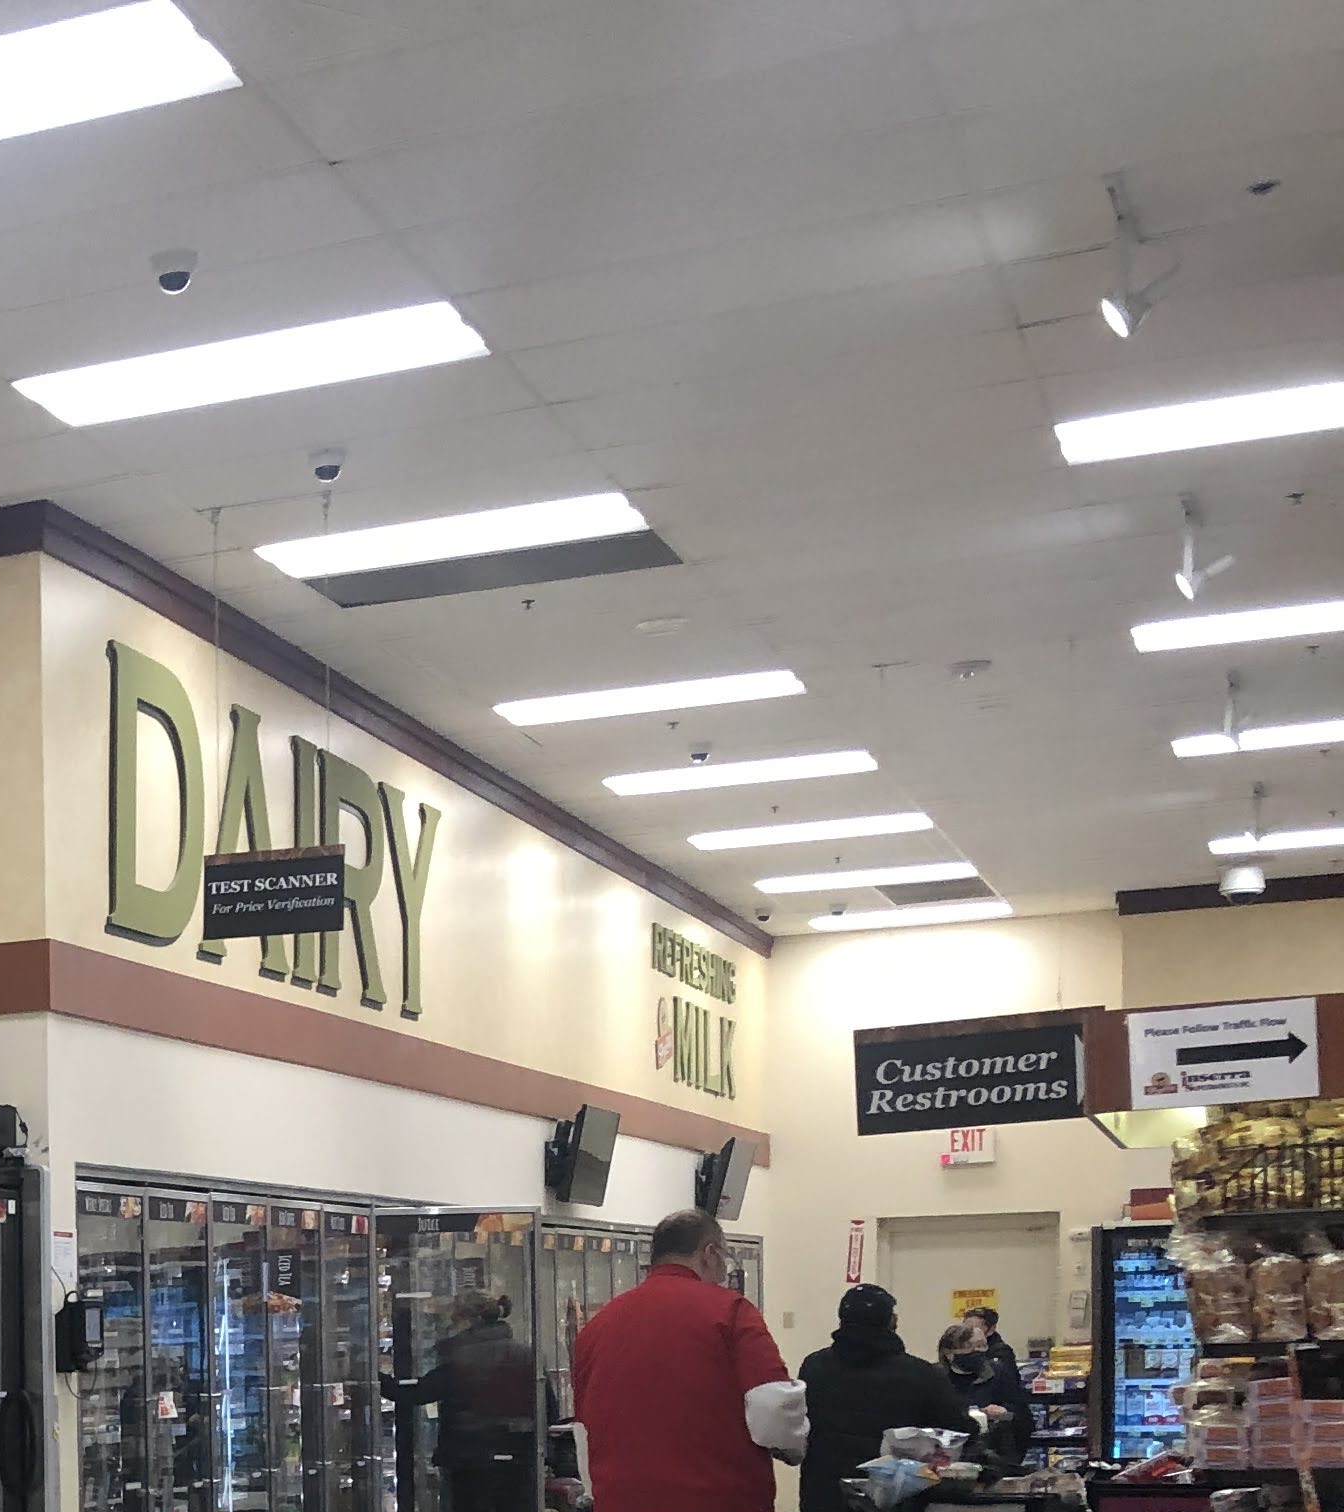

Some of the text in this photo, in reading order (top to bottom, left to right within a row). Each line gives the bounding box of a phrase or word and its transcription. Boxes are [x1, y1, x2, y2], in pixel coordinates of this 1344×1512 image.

[105, 639, 442, 1020] DAIRY
[208, 873, 338, 895] TEST SCANNER
[212, 896, 335, 915] For Price Verification
[651, 922, 737, 1004] REFRESHING
[1182, 1023, 1219, 1035] Follow
[1222, 1018, 1257, 1031] Traffic
[1259, 1017, 1287, 1028] Flow
[673, 996, 737, 1100] MILK
[875, 1050, 1058, 1085] Customer
[865, 1079, 1069, 1115] Restrooms
[950, 1128, 986, 1153] EXIT
